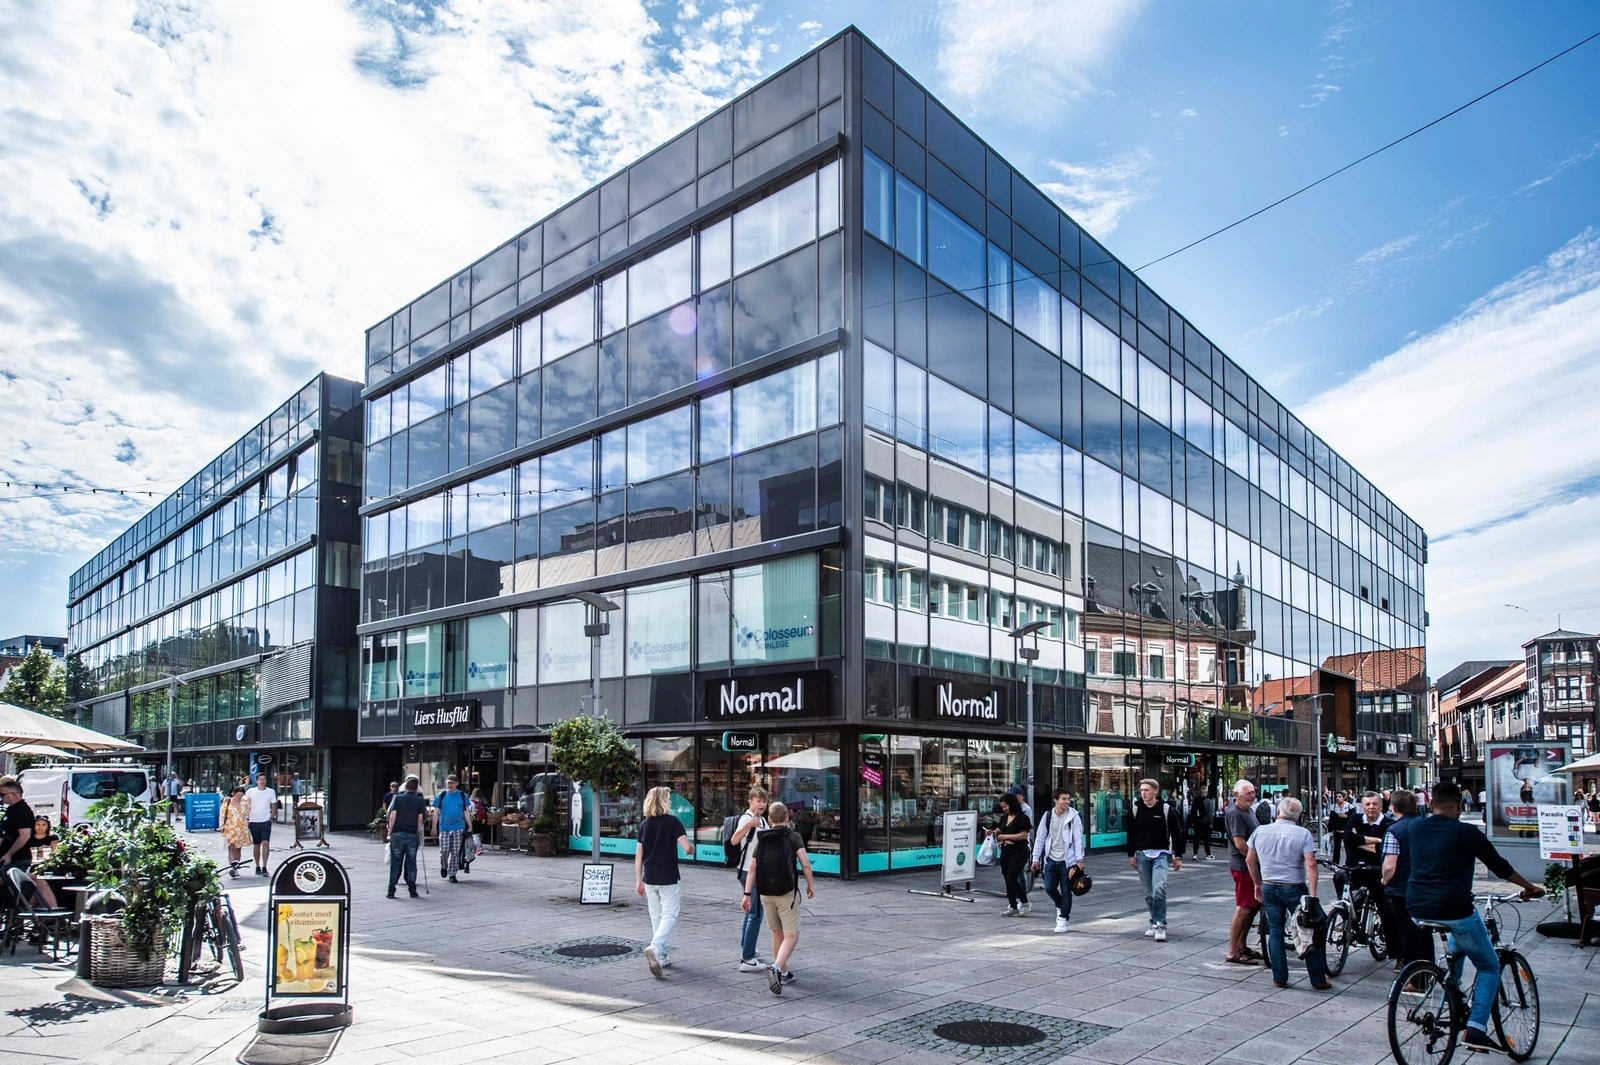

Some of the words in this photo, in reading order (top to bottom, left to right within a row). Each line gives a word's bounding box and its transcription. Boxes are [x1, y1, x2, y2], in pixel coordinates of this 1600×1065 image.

[754, 625, 814, 643] Colosseum
[755, 639, 789, 650] TANNLEGE
[720, 677, 803, 715] Normal
[939, 681, 998, 719] Normal
[414, 710, 435, 726] Liers
[436, 705, 469, 727] Husflid
[1224, 718, 1250, 742] Normal
[730, 735, 755, 747] Normal
[1166, 755, 1189, 764] Normal
[297, 862, 324, 876] ESPRESSO
[314, 910, 332, 918] med
